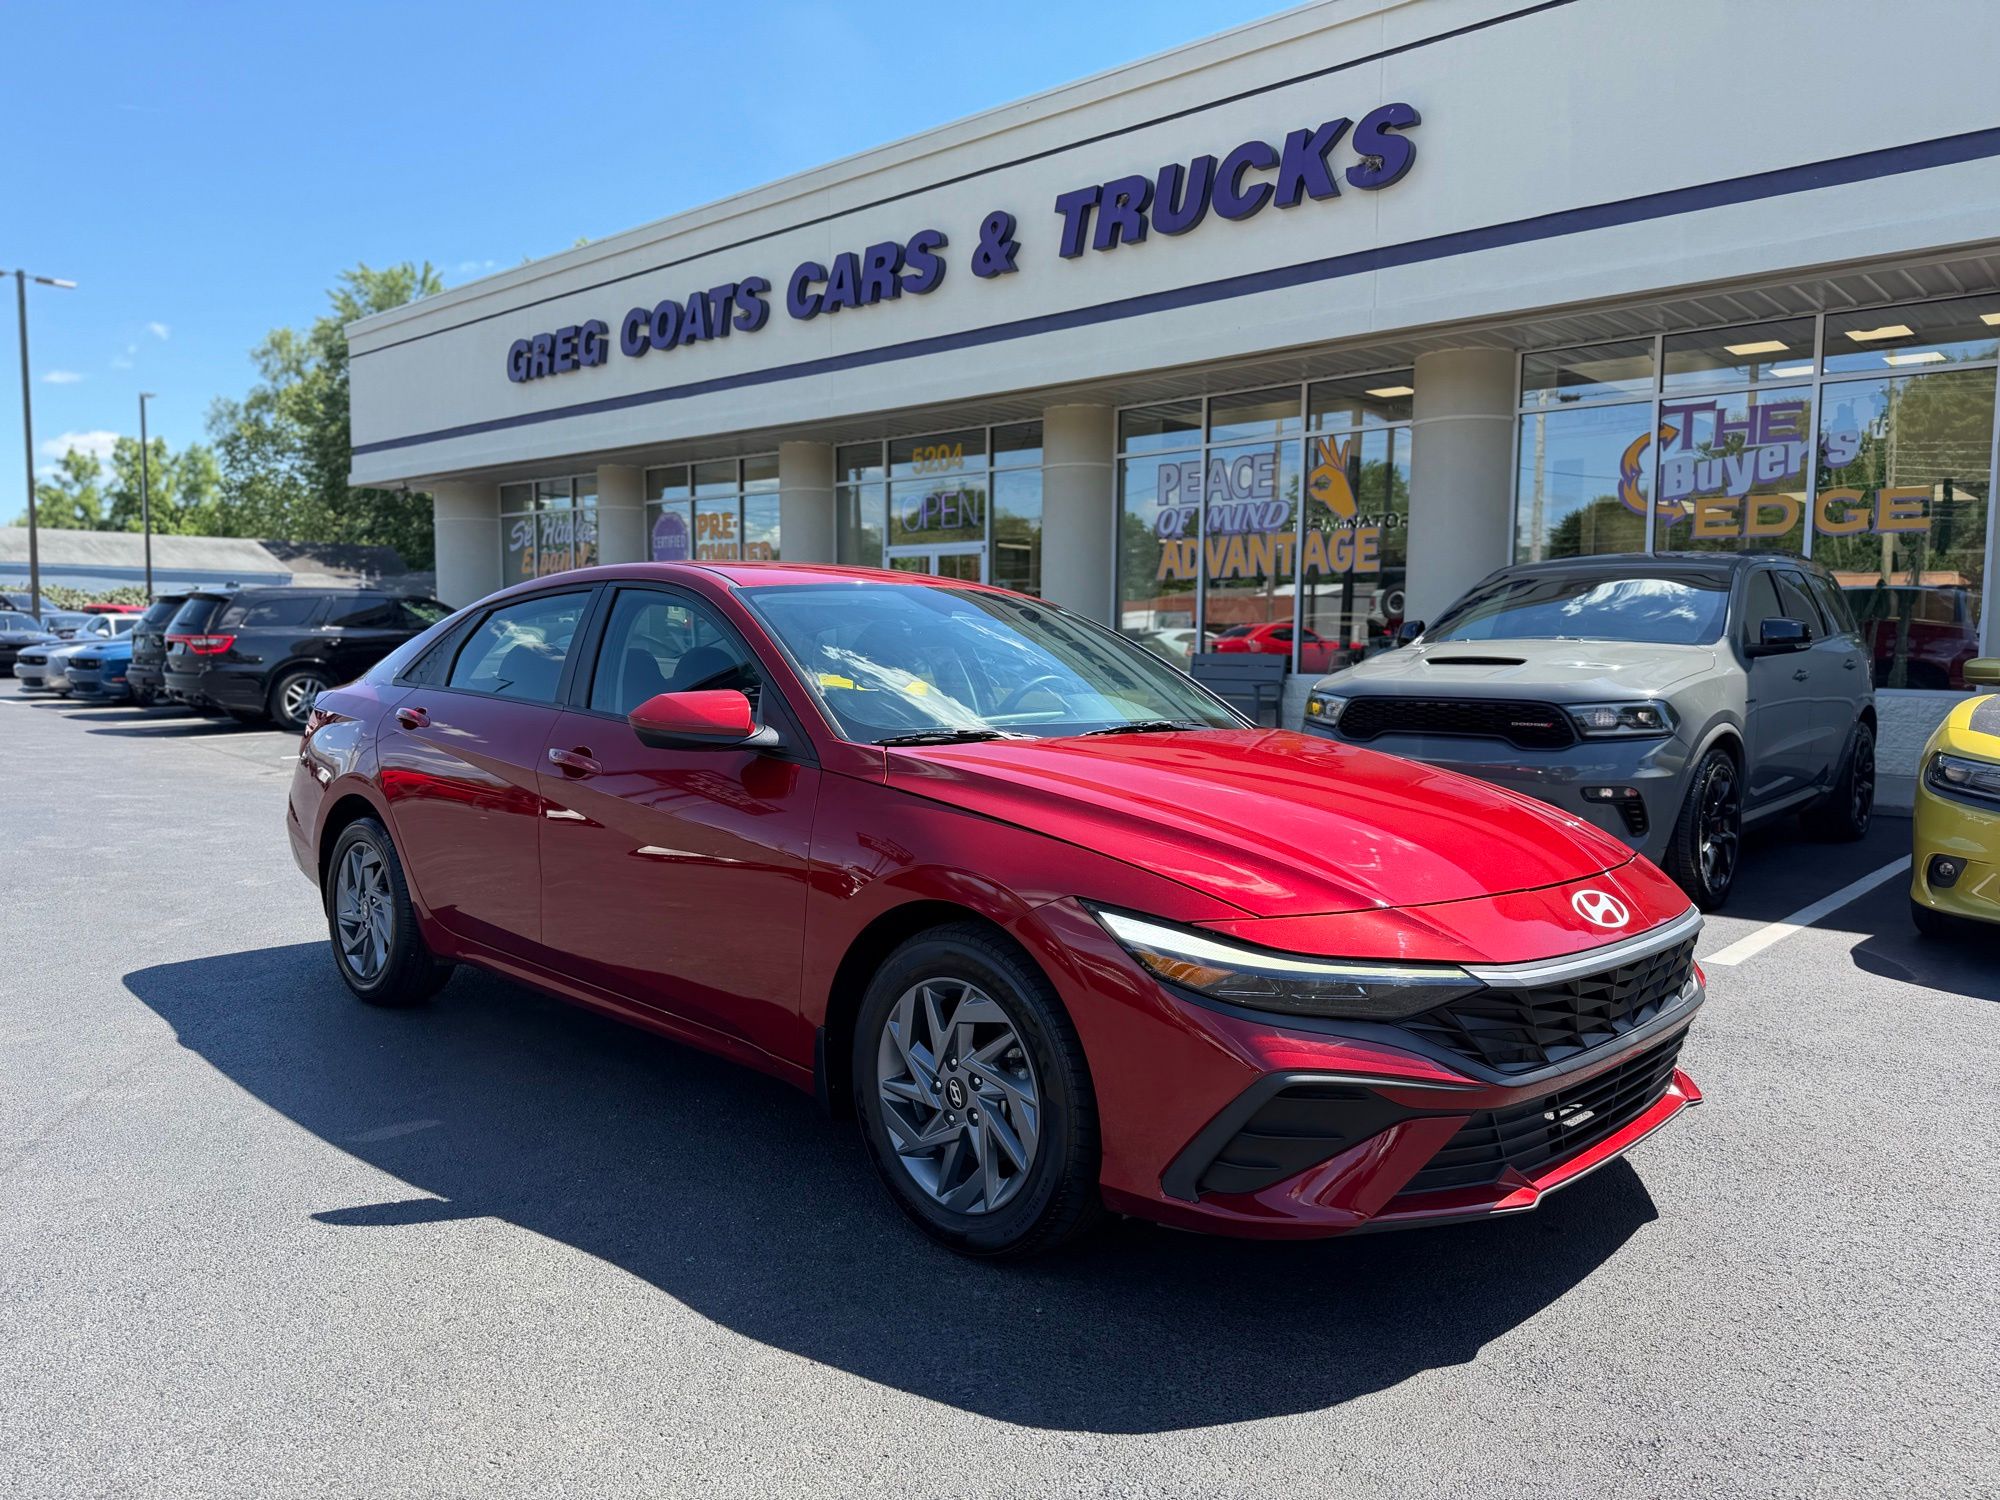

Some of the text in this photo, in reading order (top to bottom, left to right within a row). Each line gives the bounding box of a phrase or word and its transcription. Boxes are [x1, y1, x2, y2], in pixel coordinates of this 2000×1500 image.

[507, 102, 1422, 384] GREG COATS CARS & TRUCKS
[1661, 400, 1805, 453] THE
[912, 442, 965, 475] 5204
[1157, 453, 1275, 505] PEACE
[509, 520, 534, 552] Se
[902, 489, 979, 532] OPEN
[1158, 499, 1291, 538] OF MIND
[1691, 485, 1931, 539] EDGE
[1157, 528, 1381, 580] ADVANTAGE
